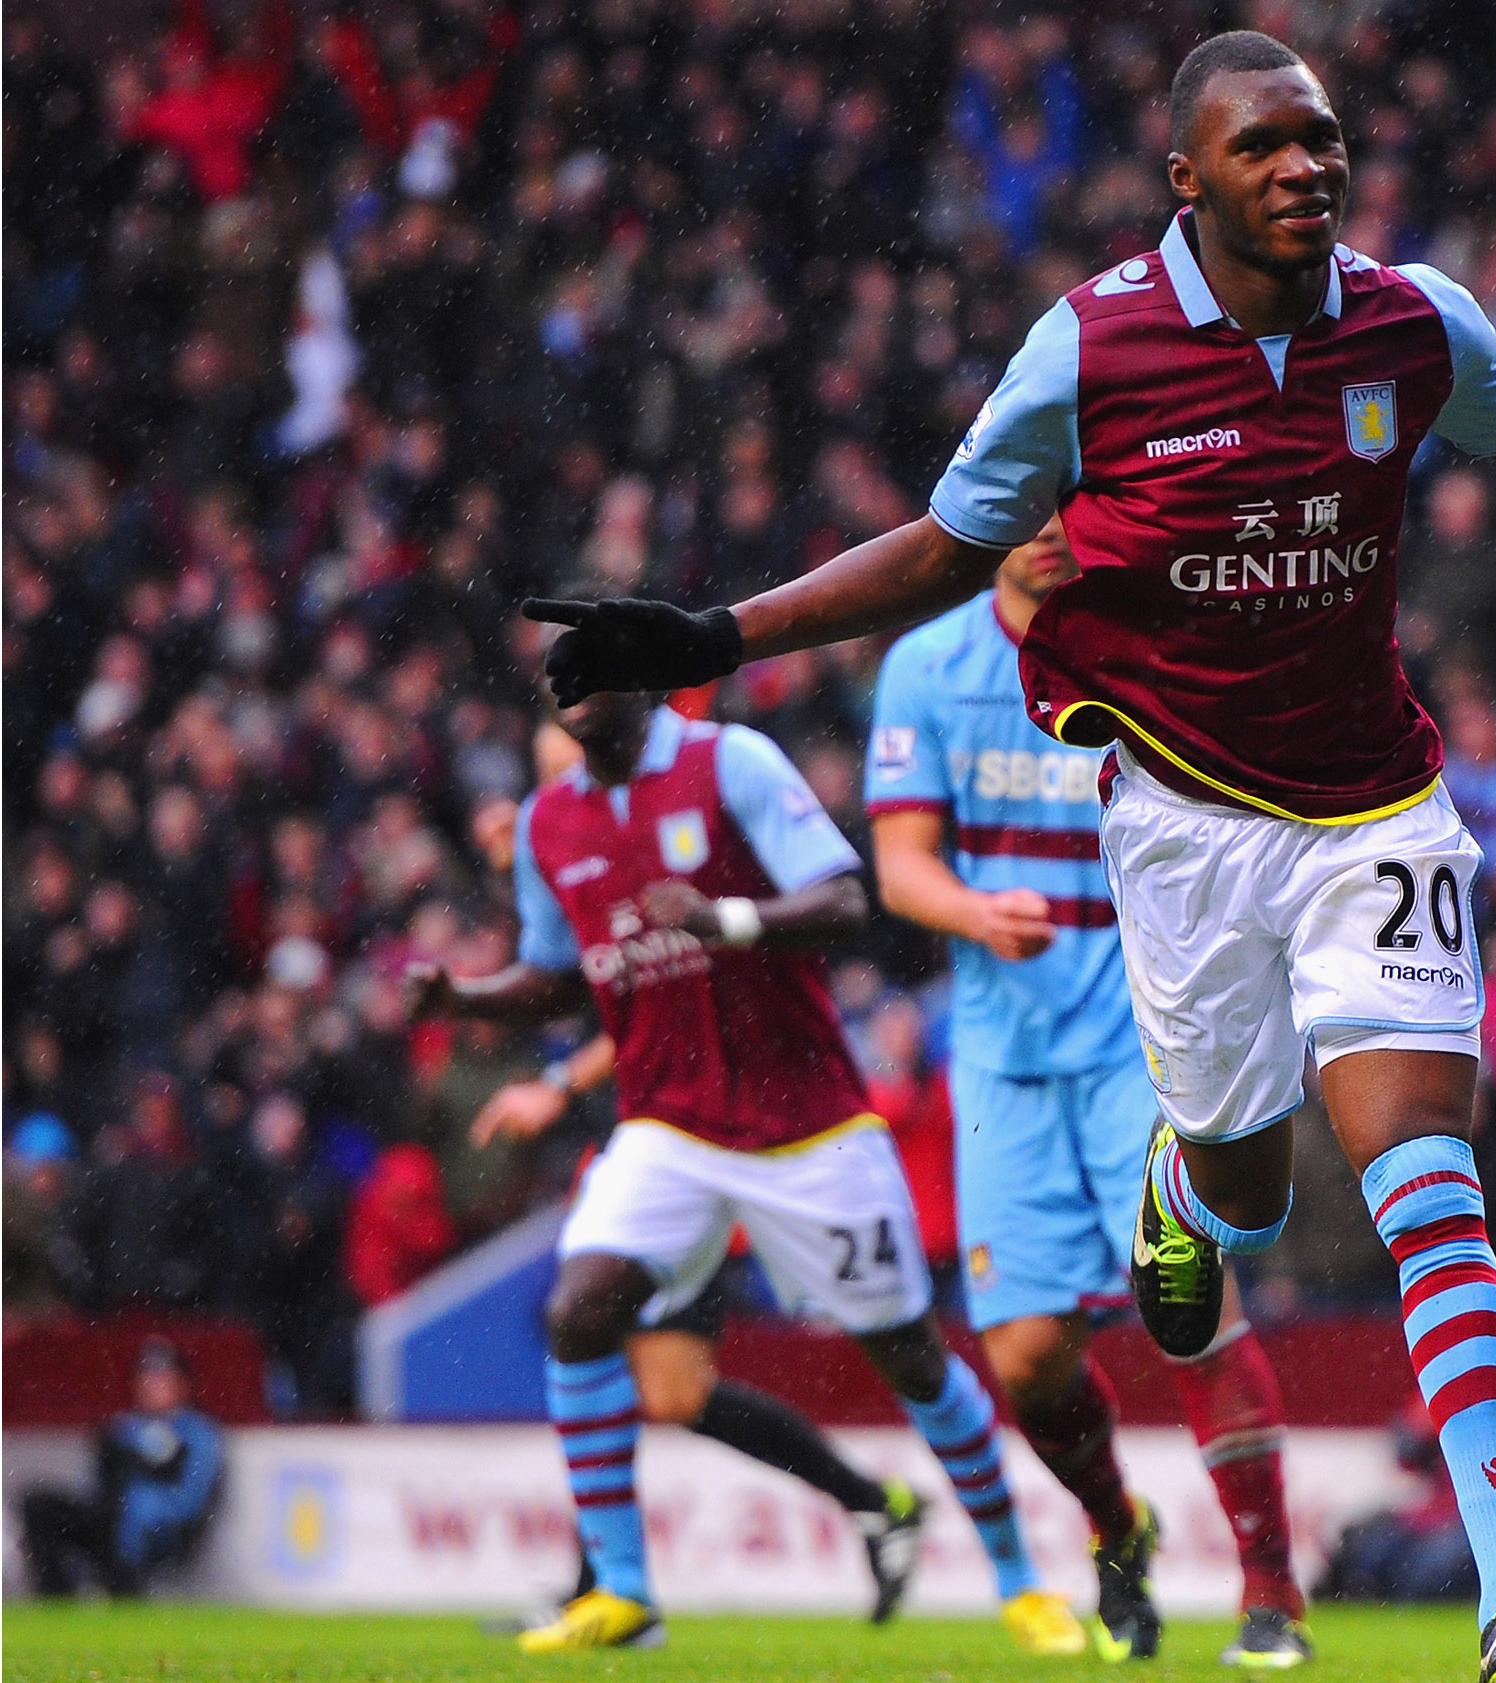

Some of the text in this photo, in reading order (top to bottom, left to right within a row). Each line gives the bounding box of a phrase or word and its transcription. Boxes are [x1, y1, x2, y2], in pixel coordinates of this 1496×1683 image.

[1352, 387, 1389, 402] AVFC
[1146, 428, 1241, 458] macron
[1232, 491, 1342, 542] 云顶
[1170, 535, 1379, 592] GENTING
[977, 750, 1100, 803] SBOB
[1374, 858, 1465, 956] 20
[1381, 964, 1464, 990] macron
[824, 1216, 900, 1282] 24
